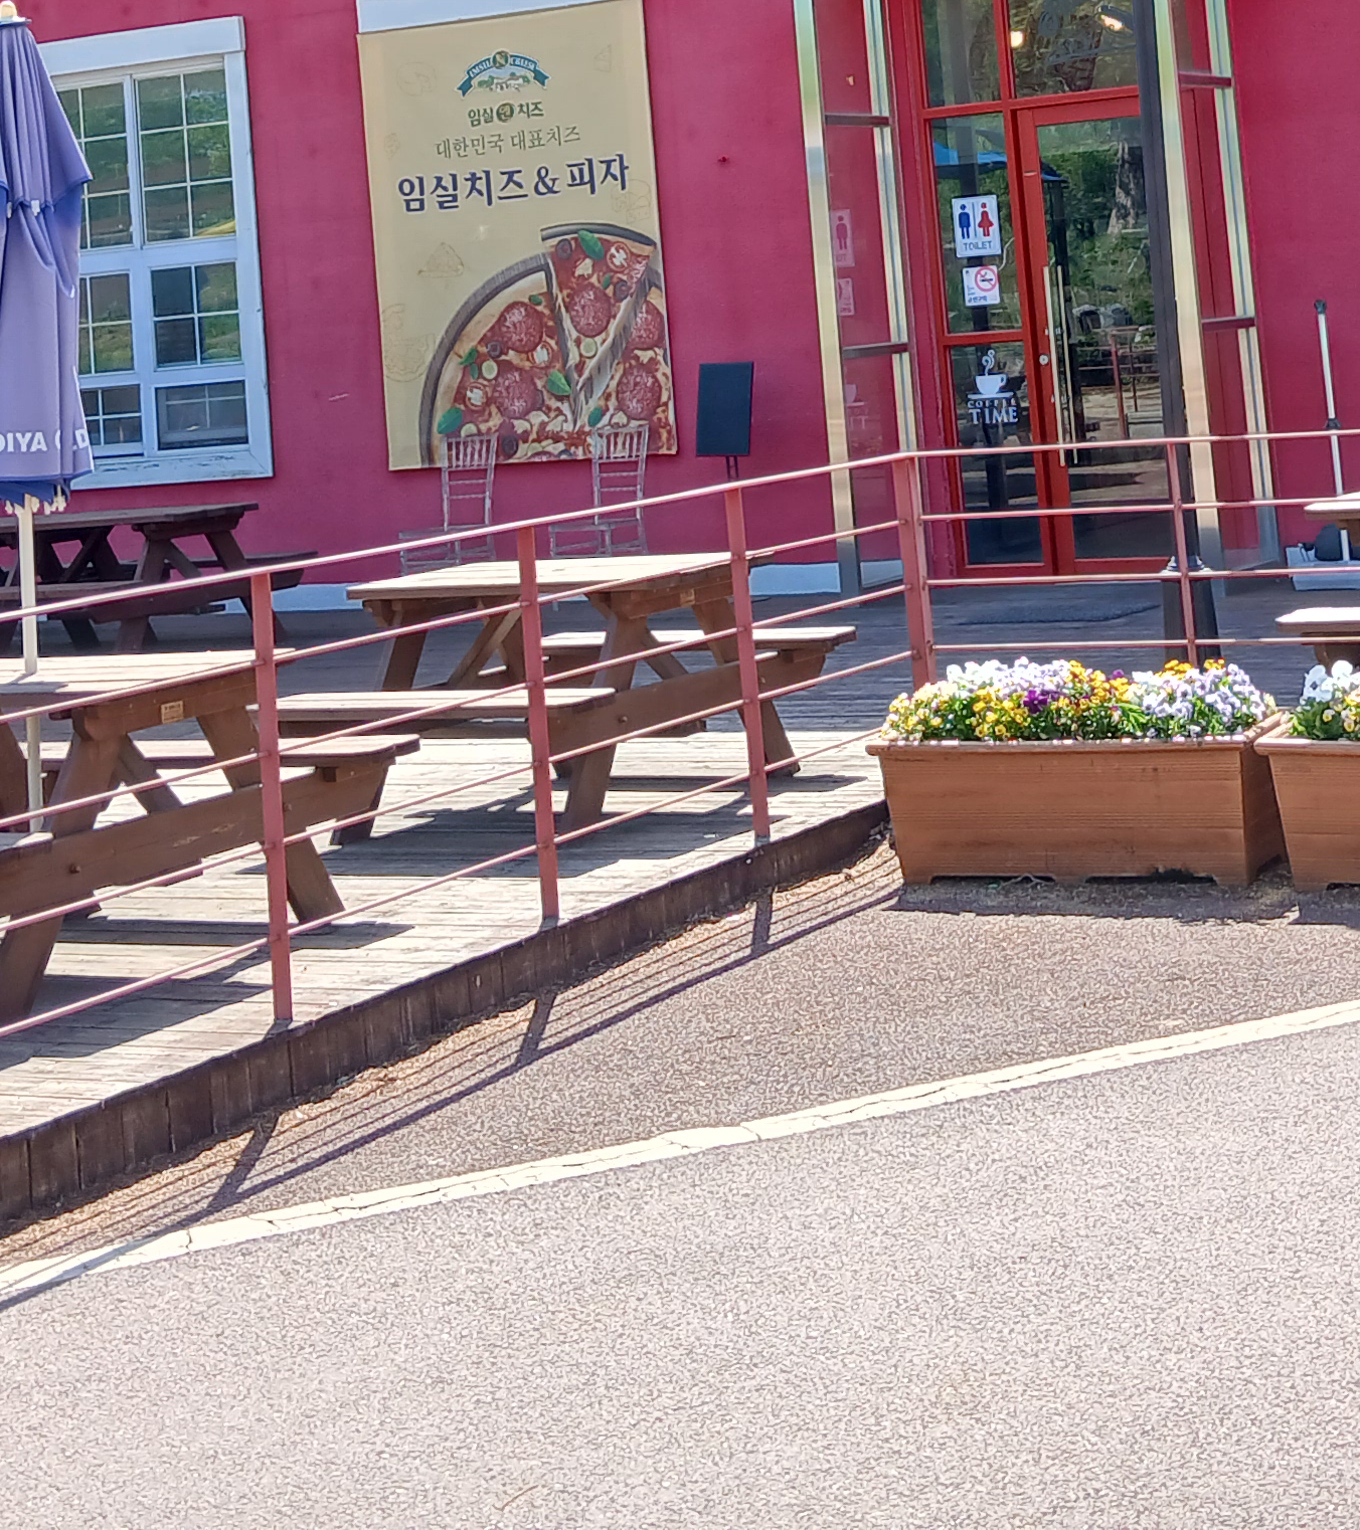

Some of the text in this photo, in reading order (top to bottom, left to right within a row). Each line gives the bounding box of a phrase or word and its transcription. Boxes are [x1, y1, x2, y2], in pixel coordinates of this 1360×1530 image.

[435, 125, 581, 159] 대한민국 대표치즈
[962, 240, 993, 251] TOILET
[968, 406, 1019, 425] TIME
